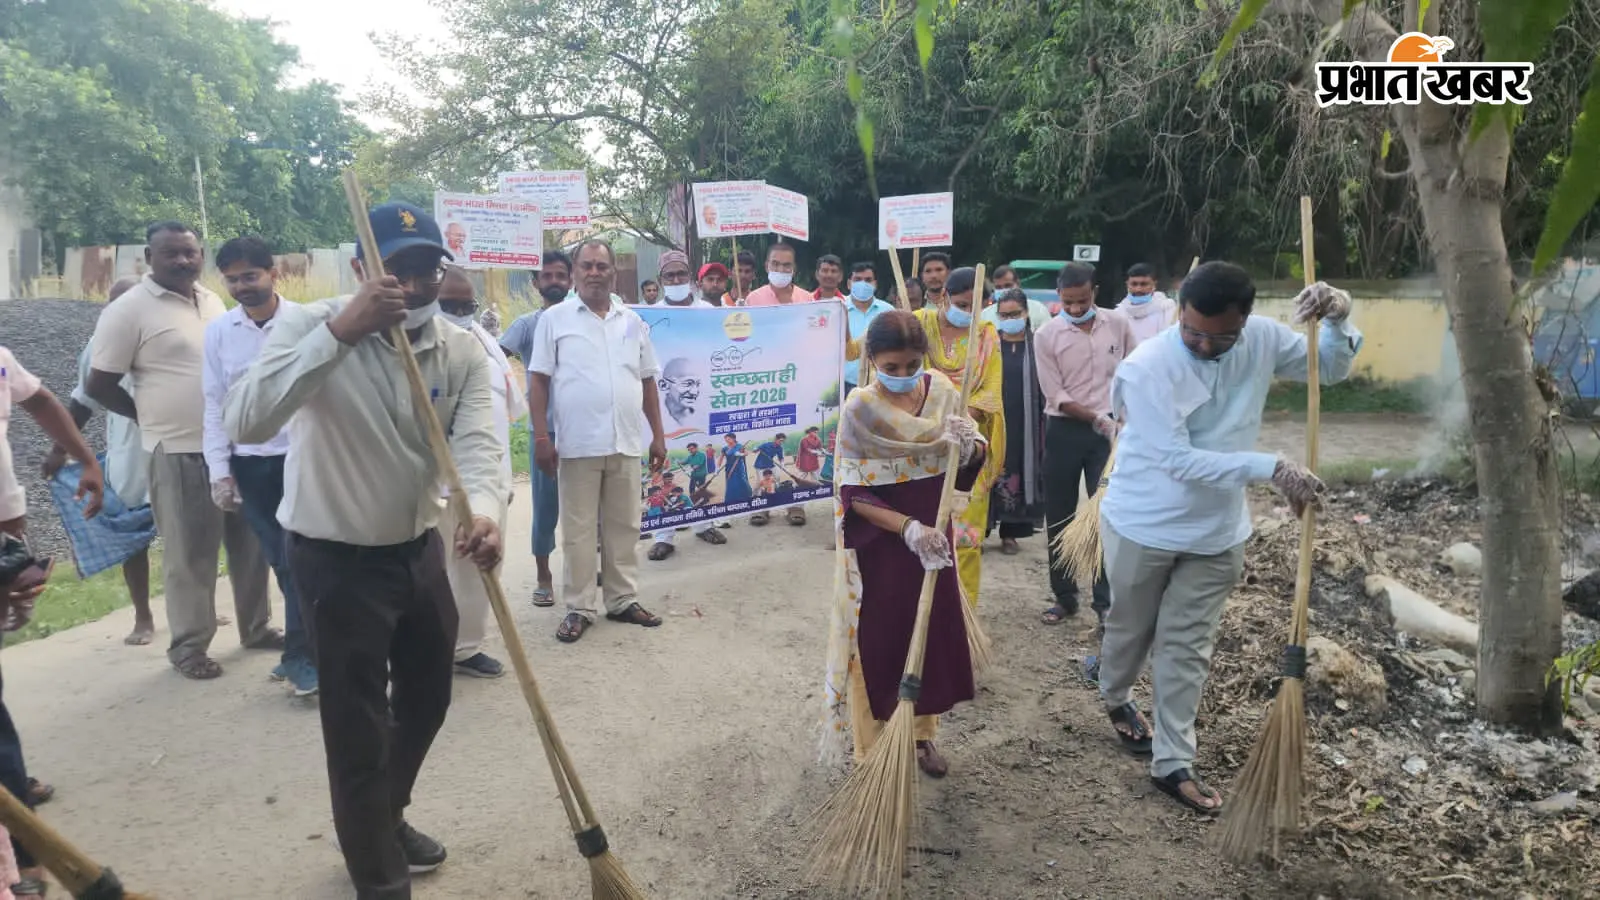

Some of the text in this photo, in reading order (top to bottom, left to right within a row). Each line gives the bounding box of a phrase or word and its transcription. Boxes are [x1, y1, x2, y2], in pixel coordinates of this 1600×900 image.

[710, 363, 797, 389] स्वच्छता ही
[710, 390, 746, 409] सेवा
